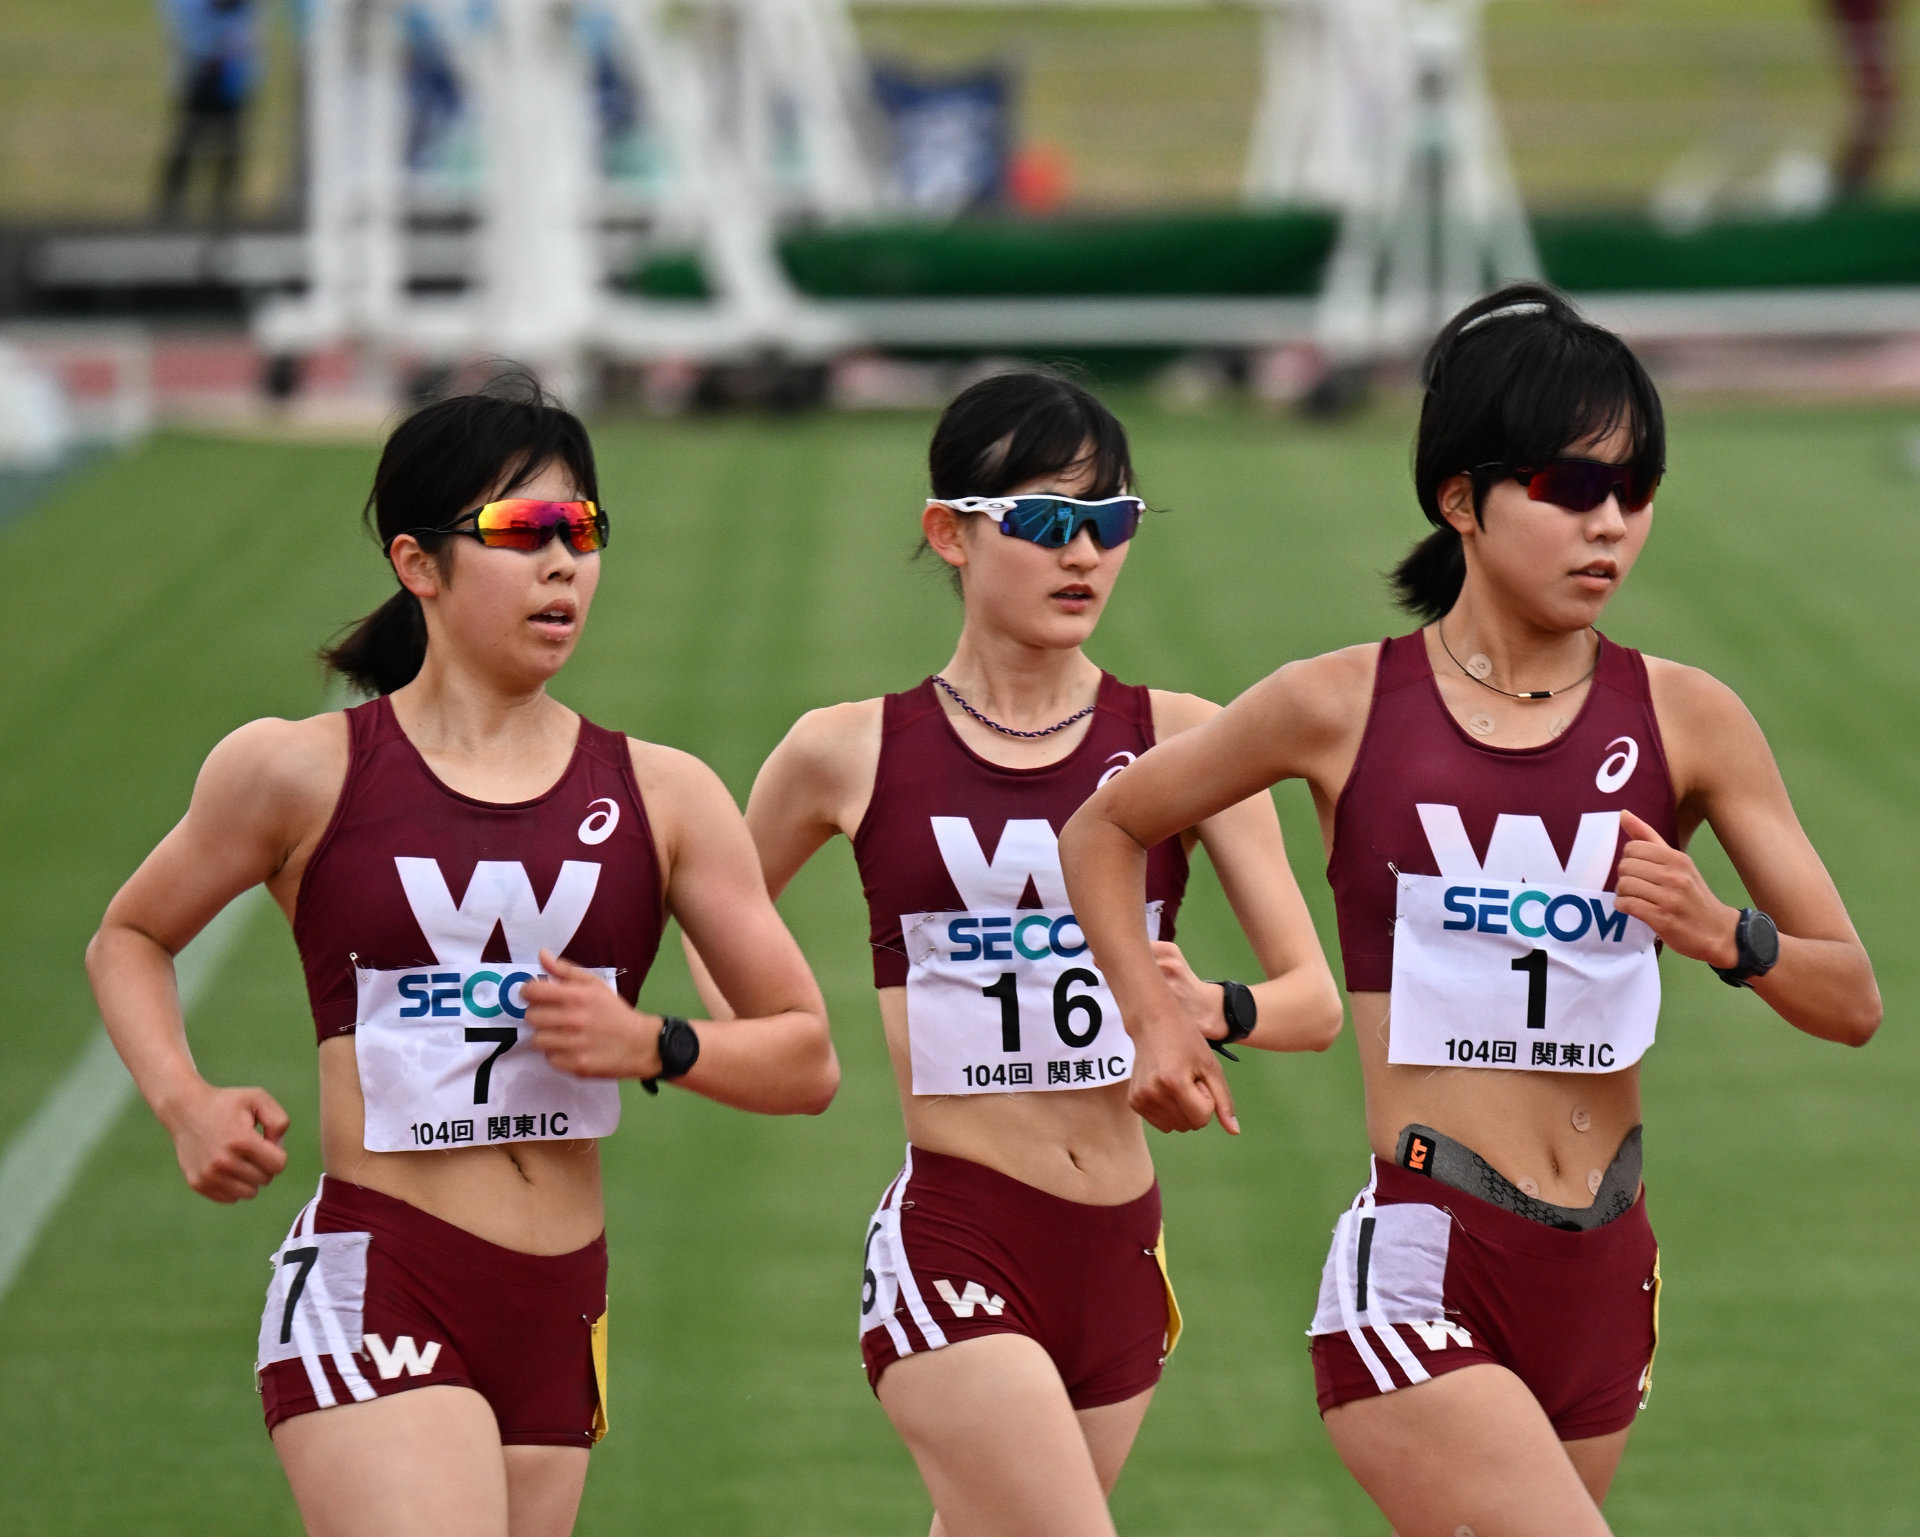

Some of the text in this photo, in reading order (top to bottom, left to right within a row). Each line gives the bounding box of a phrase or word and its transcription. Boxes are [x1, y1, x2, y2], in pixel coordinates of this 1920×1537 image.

[1415, 803, 1621, 891] W
[393, 856, 602, 966] W
[1443, 886, 1629, 942] SECOM
[948, 914, 1087, 962] SECO
[398, 970, 550, 1019] SECO
[981, 967, 1103, 1053] 16
[1511, 948, 1549, 1030] 1
[464, 1027, 518, 1105] 7
[962, 1056, 1127, 1087] 104回 関東IC
[1445, 1039, 1615, 1068] 104回 関東IC
[410, 1112, 569, 1146] 104回 関東IC
[281, 1246, 319, 1345] 7
[933, 1279, 1006, 1317] W
[363, 1333, 442, 1380] W
